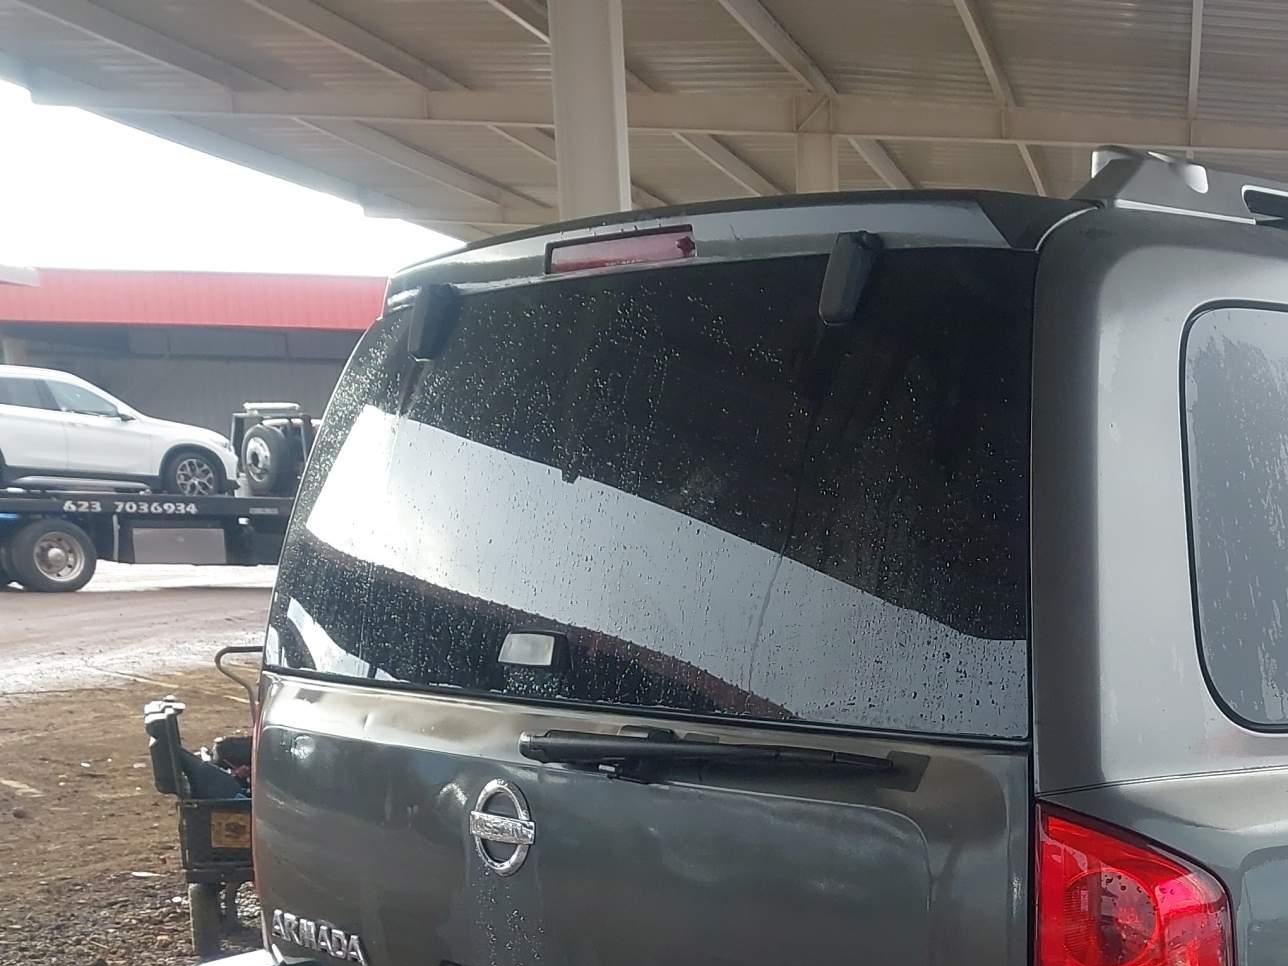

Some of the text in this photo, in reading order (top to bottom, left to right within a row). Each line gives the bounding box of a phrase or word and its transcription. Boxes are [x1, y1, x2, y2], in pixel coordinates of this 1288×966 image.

[63, 500, 198, 514] 623 7036934
[272, 909, 368, 966] ARMADA
